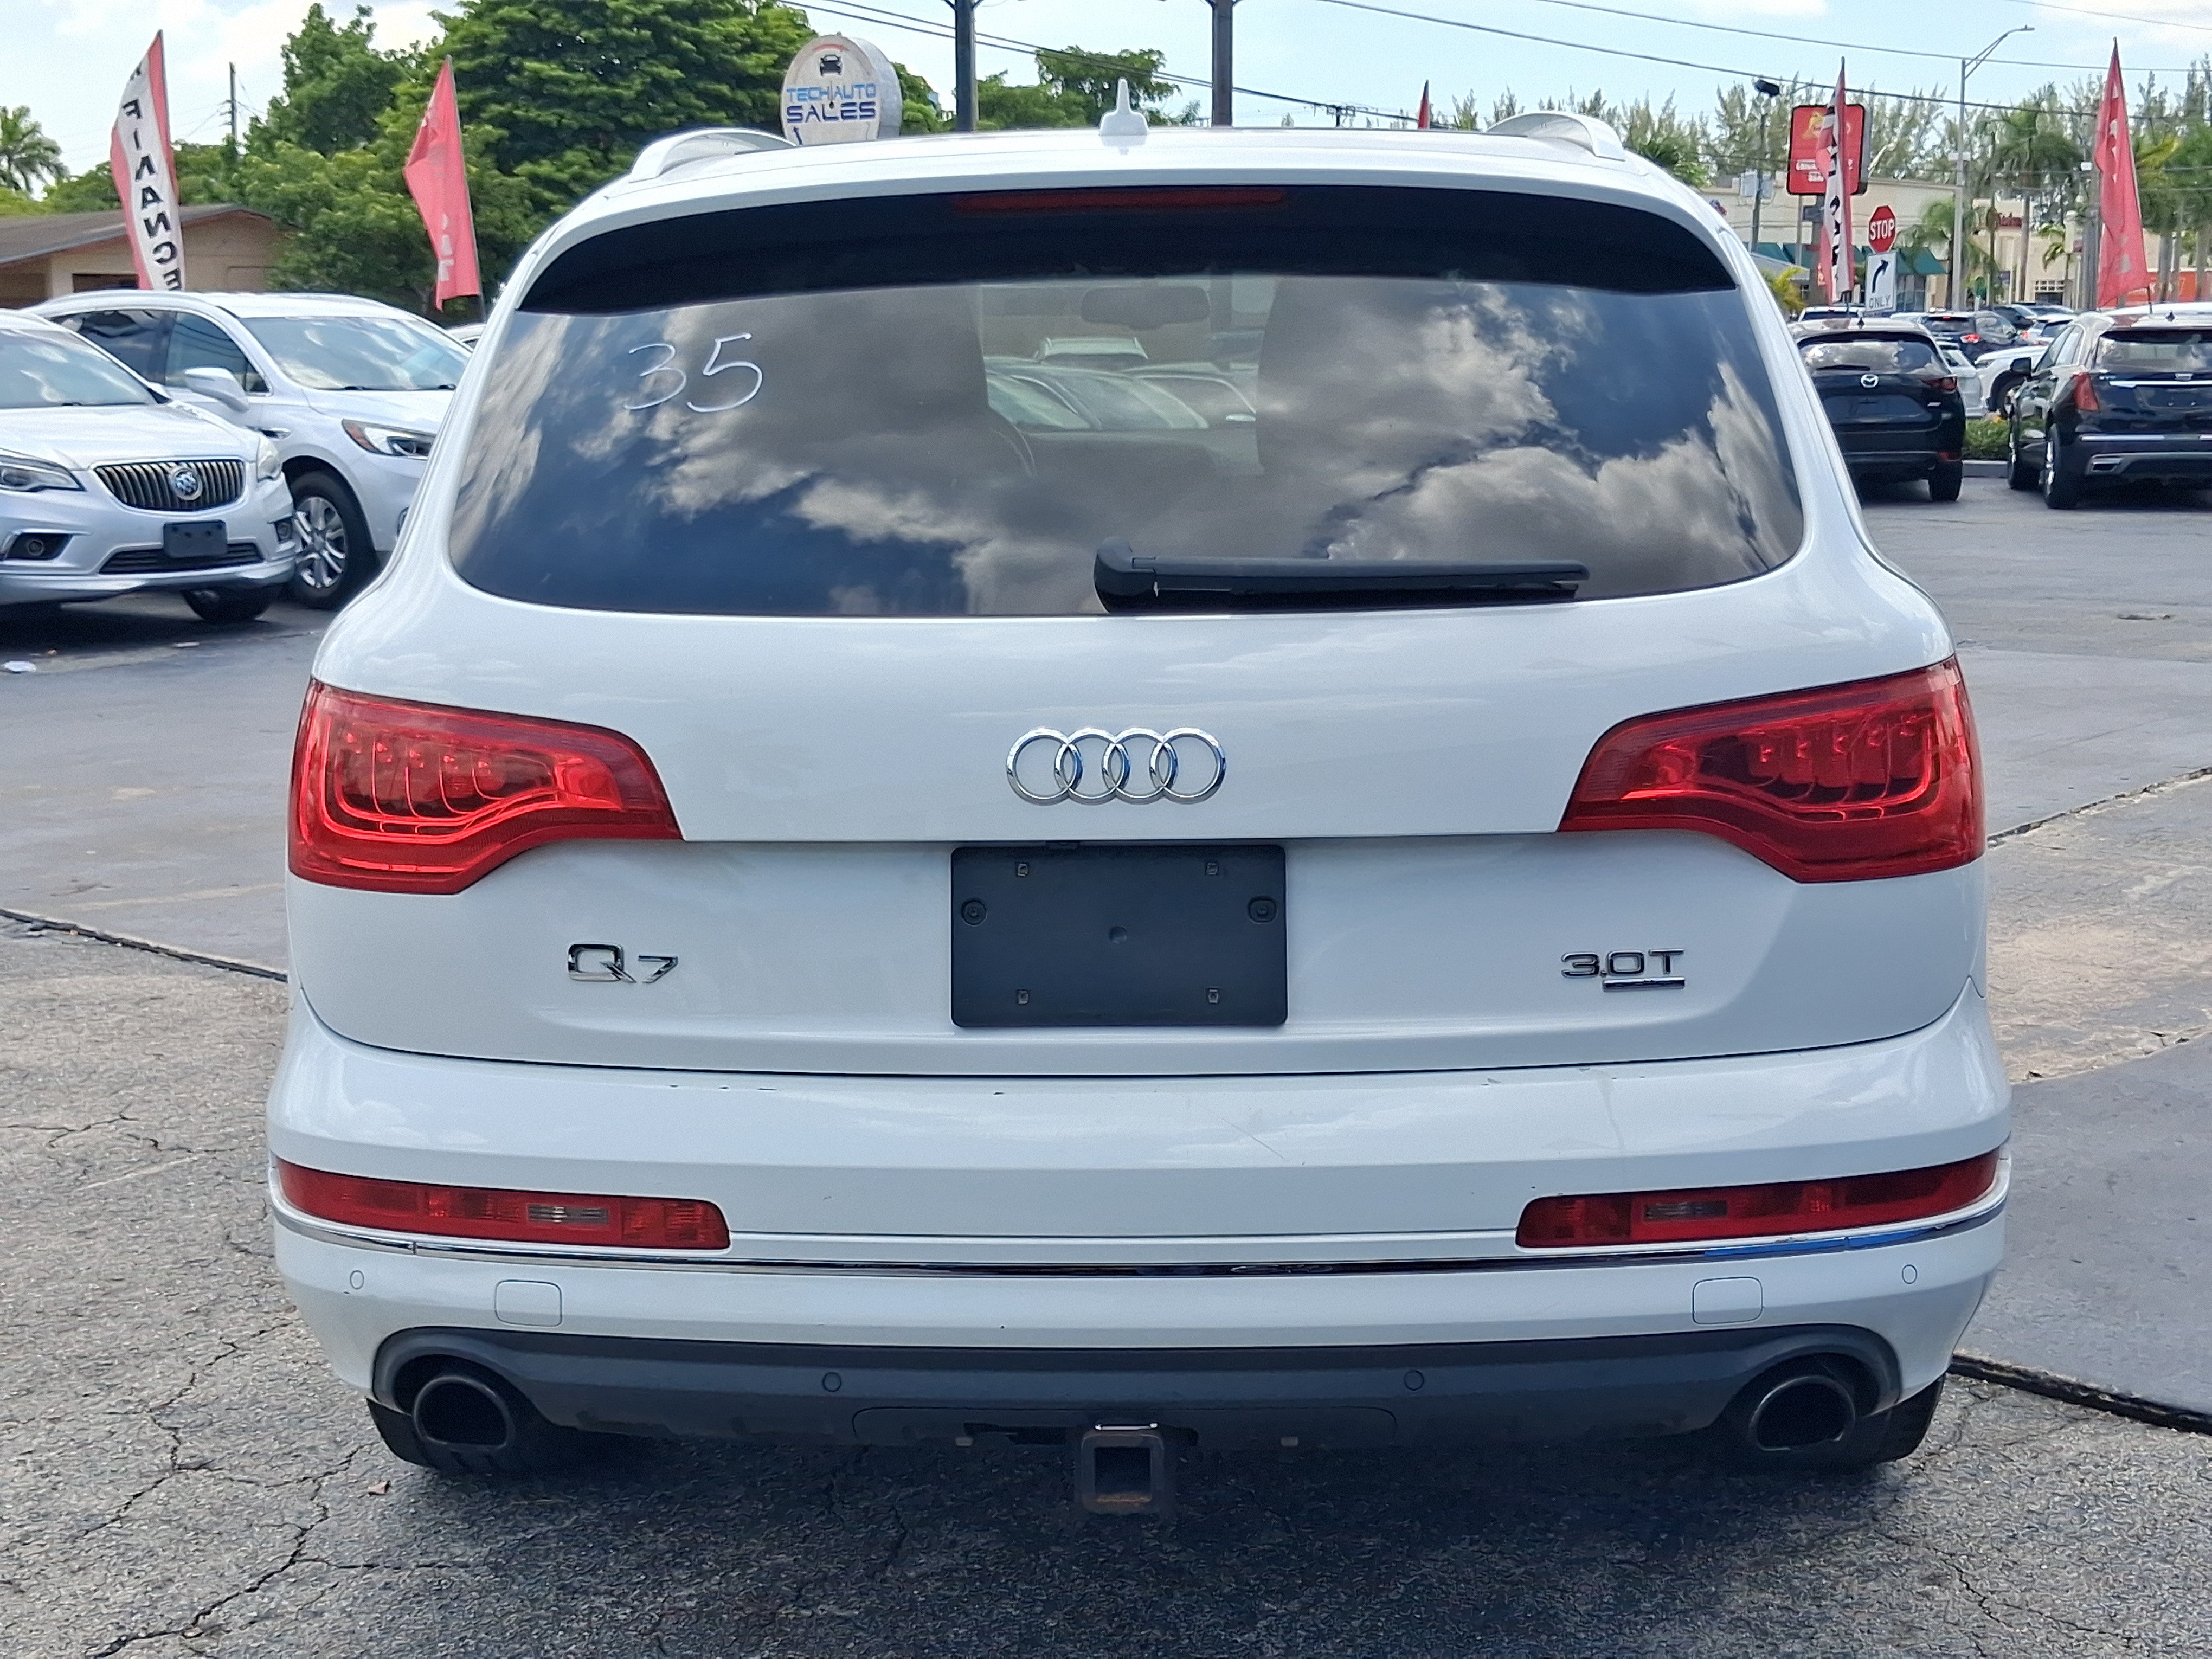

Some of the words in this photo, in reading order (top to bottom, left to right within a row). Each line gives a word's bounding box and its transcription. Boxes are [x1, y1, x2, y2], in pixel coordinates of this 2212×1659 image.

[787, 101, 876, 123] SALES
[1870, 219, 1895, 241] STOP
[1869, 295, 1891, 308] ONLY
[625, 333, 763, 413] 35
[568, 942, 678, 984] Q7
[1561, 949, 1684, 978] 3.0T
